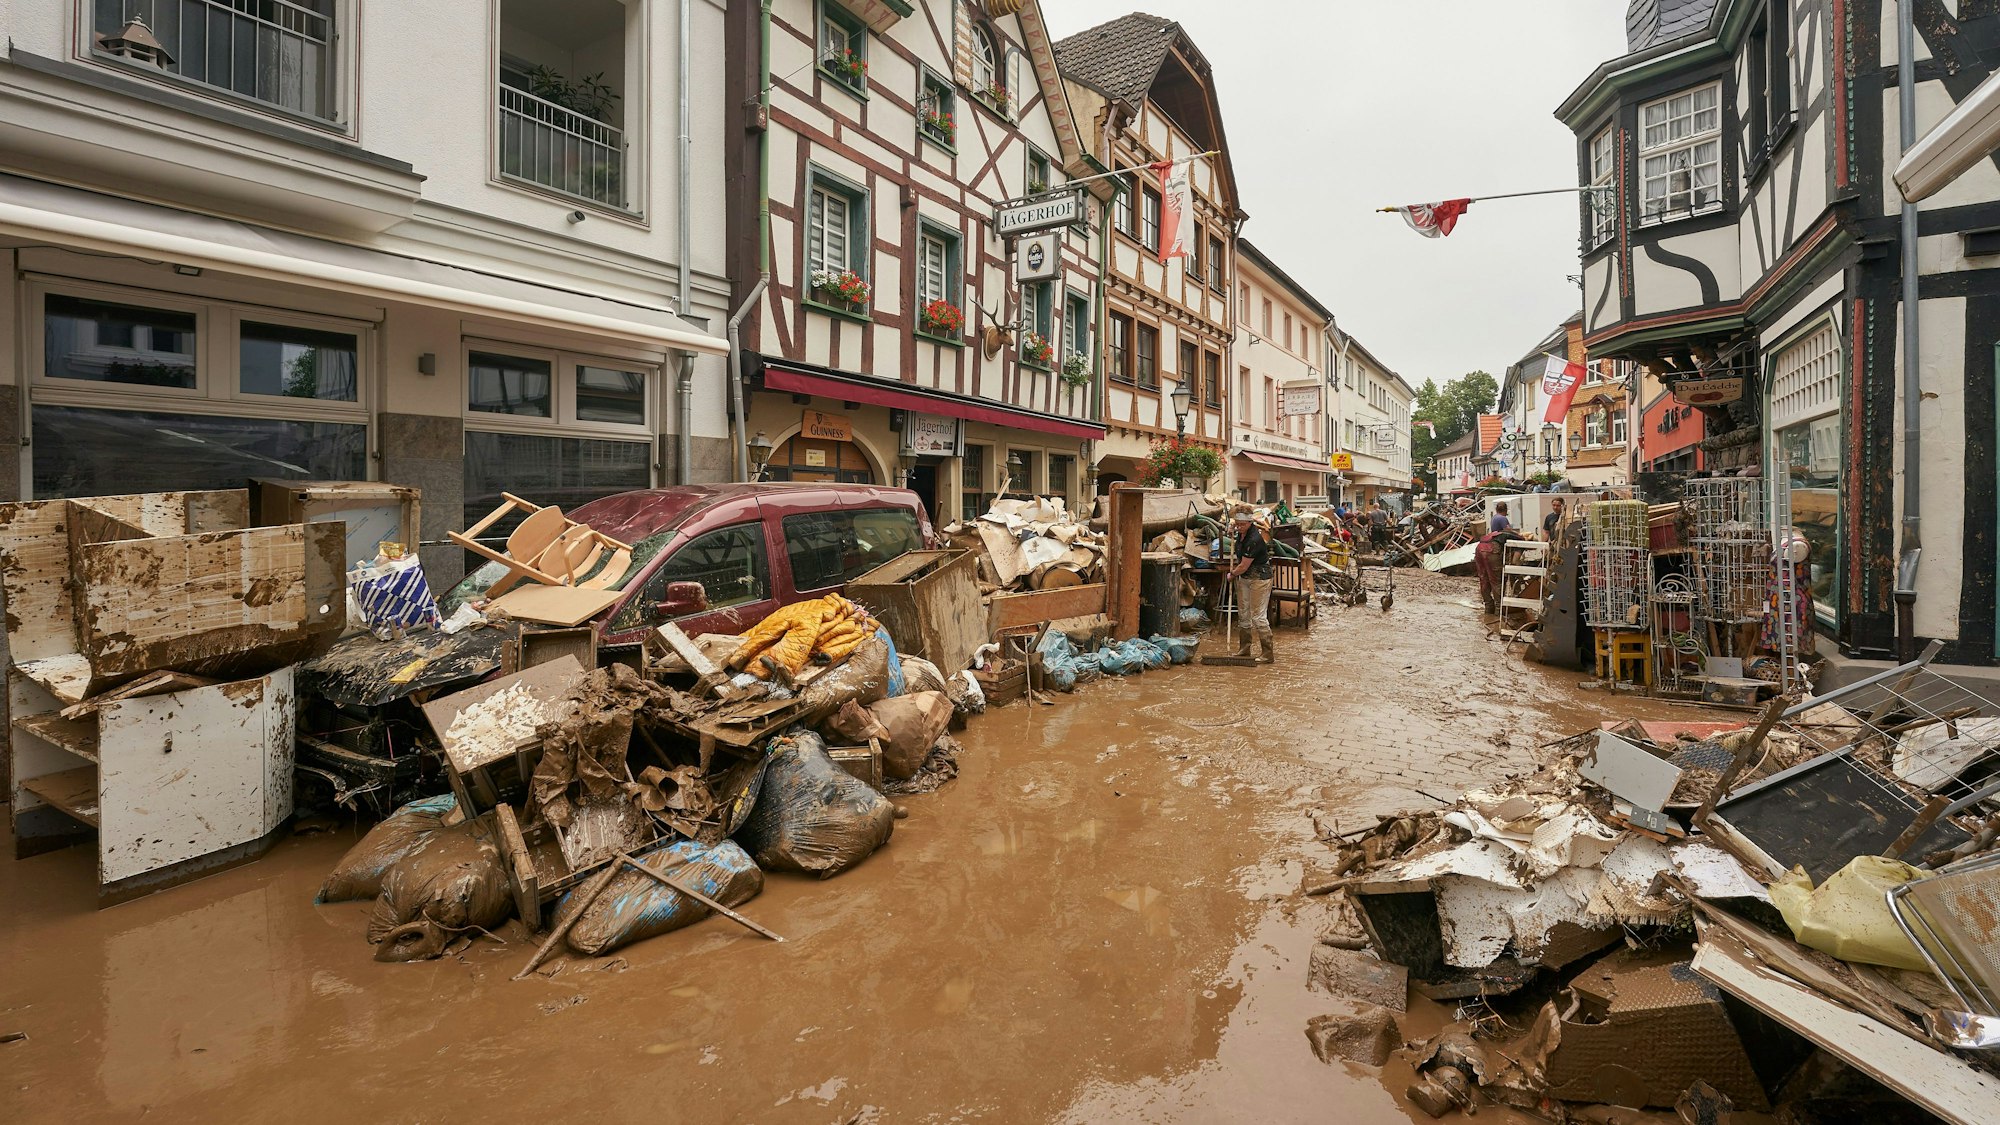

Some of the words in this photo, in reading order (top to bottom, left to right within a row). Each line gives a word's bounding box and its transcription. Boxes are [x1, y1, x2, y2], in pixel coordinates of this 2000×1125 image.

[1001, 201, 1074, 229] JÄGERHOF
[810, 423, 844, 438] GUINNESS
[916, 417, 955, 436] Jägerhof
